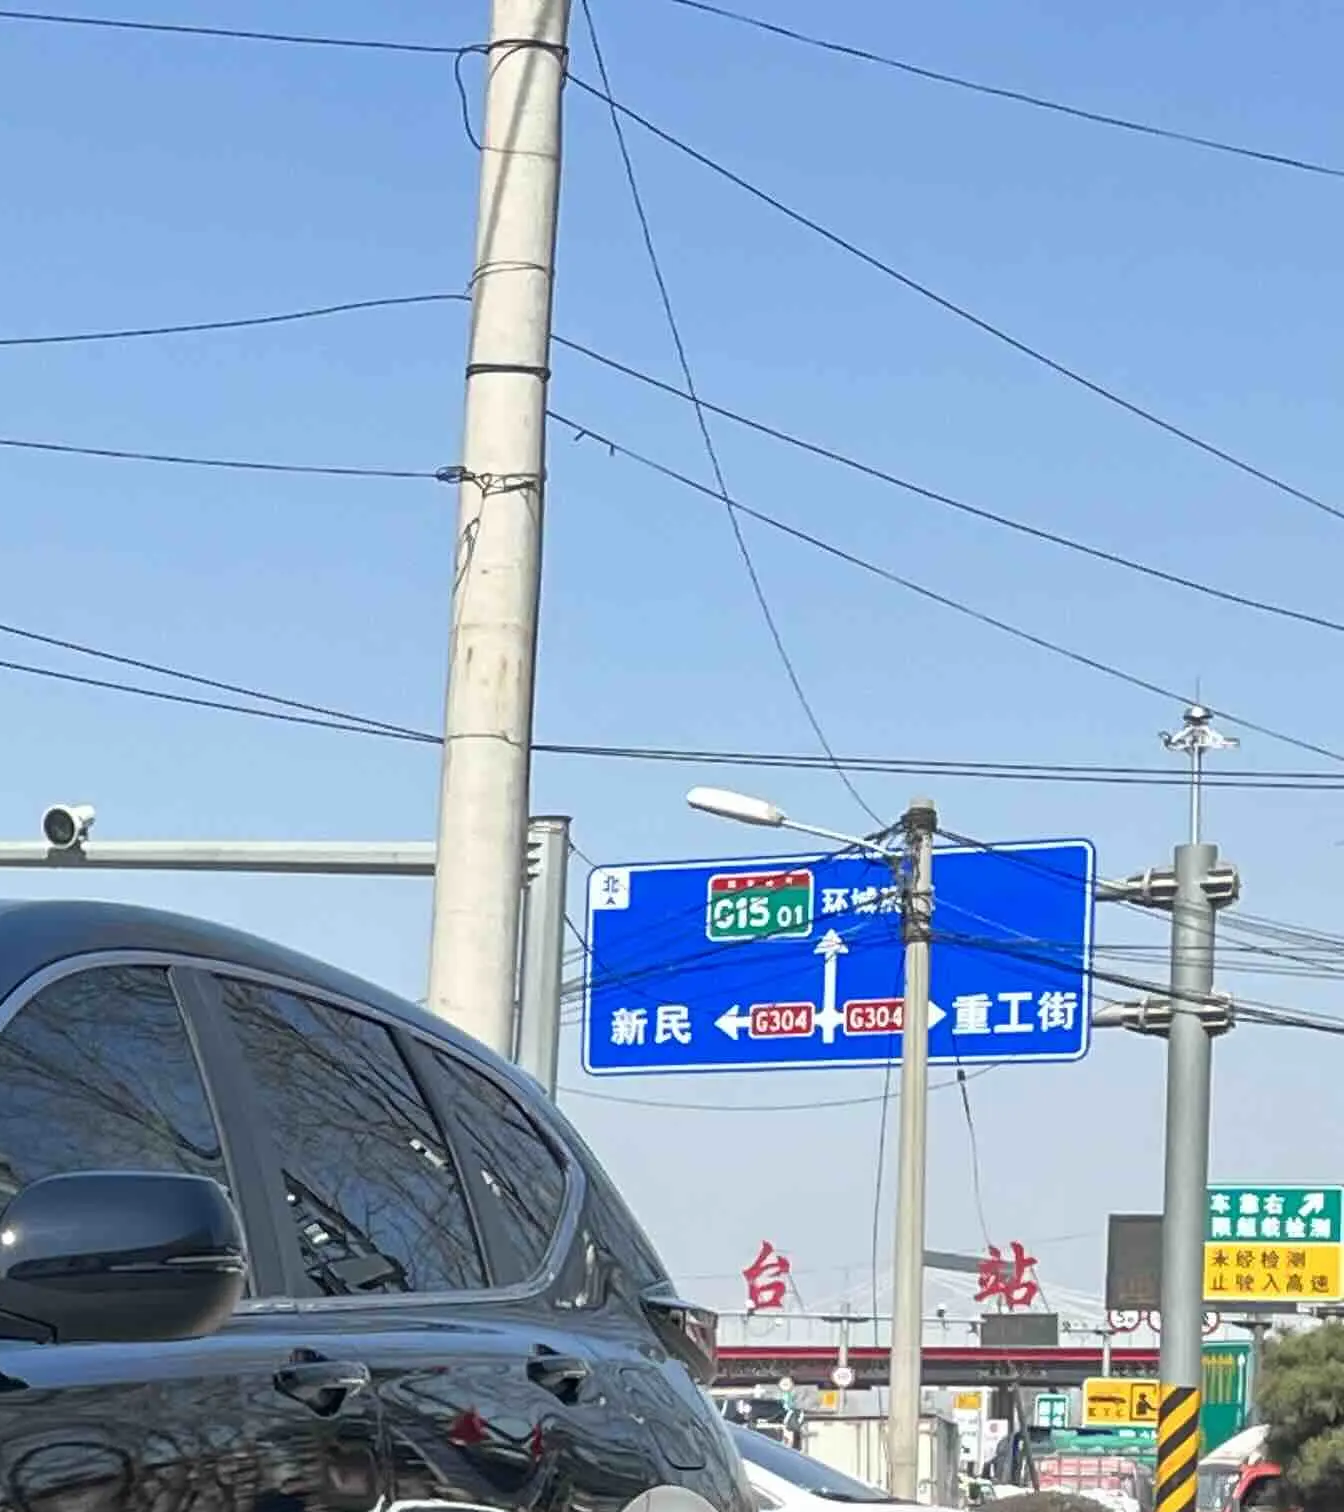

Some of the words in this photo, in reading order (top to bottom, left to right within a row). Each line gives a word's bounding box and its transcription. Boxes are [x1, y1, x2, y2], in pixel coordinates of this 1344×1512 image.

[610, 1007, 692, 1046] 新民
[756, 1010, 808, 1034] G304
[849, 1006, 903, 1030] G304
[952, 991, 1078, 1037] 重工街
[974, 1240, 1039, 1309] 站
